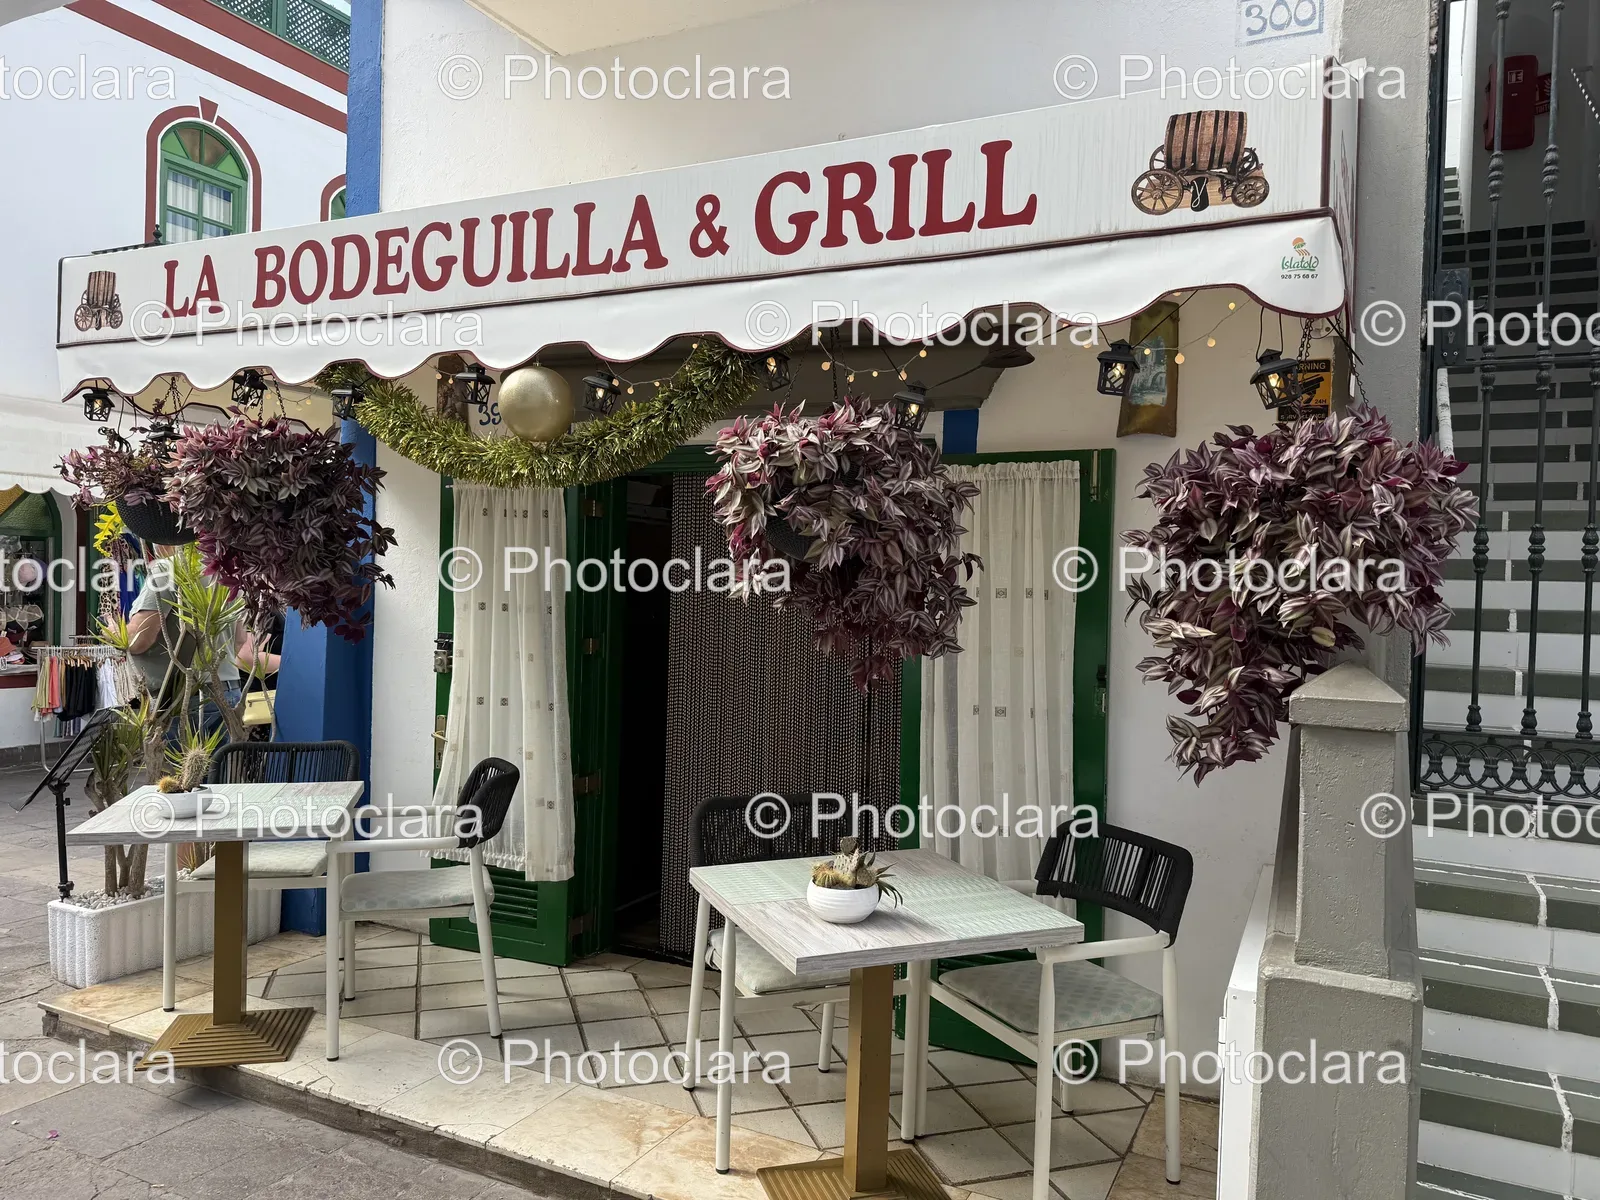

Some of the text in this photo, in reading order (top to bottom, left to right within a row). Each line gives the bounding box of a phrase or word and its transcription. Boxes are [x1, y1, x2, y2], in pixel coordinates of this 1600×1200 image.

[1245, 0, 1317, 36] 300
[162, 139, 1037, 319] LA BODEGUILLA & GRILL
